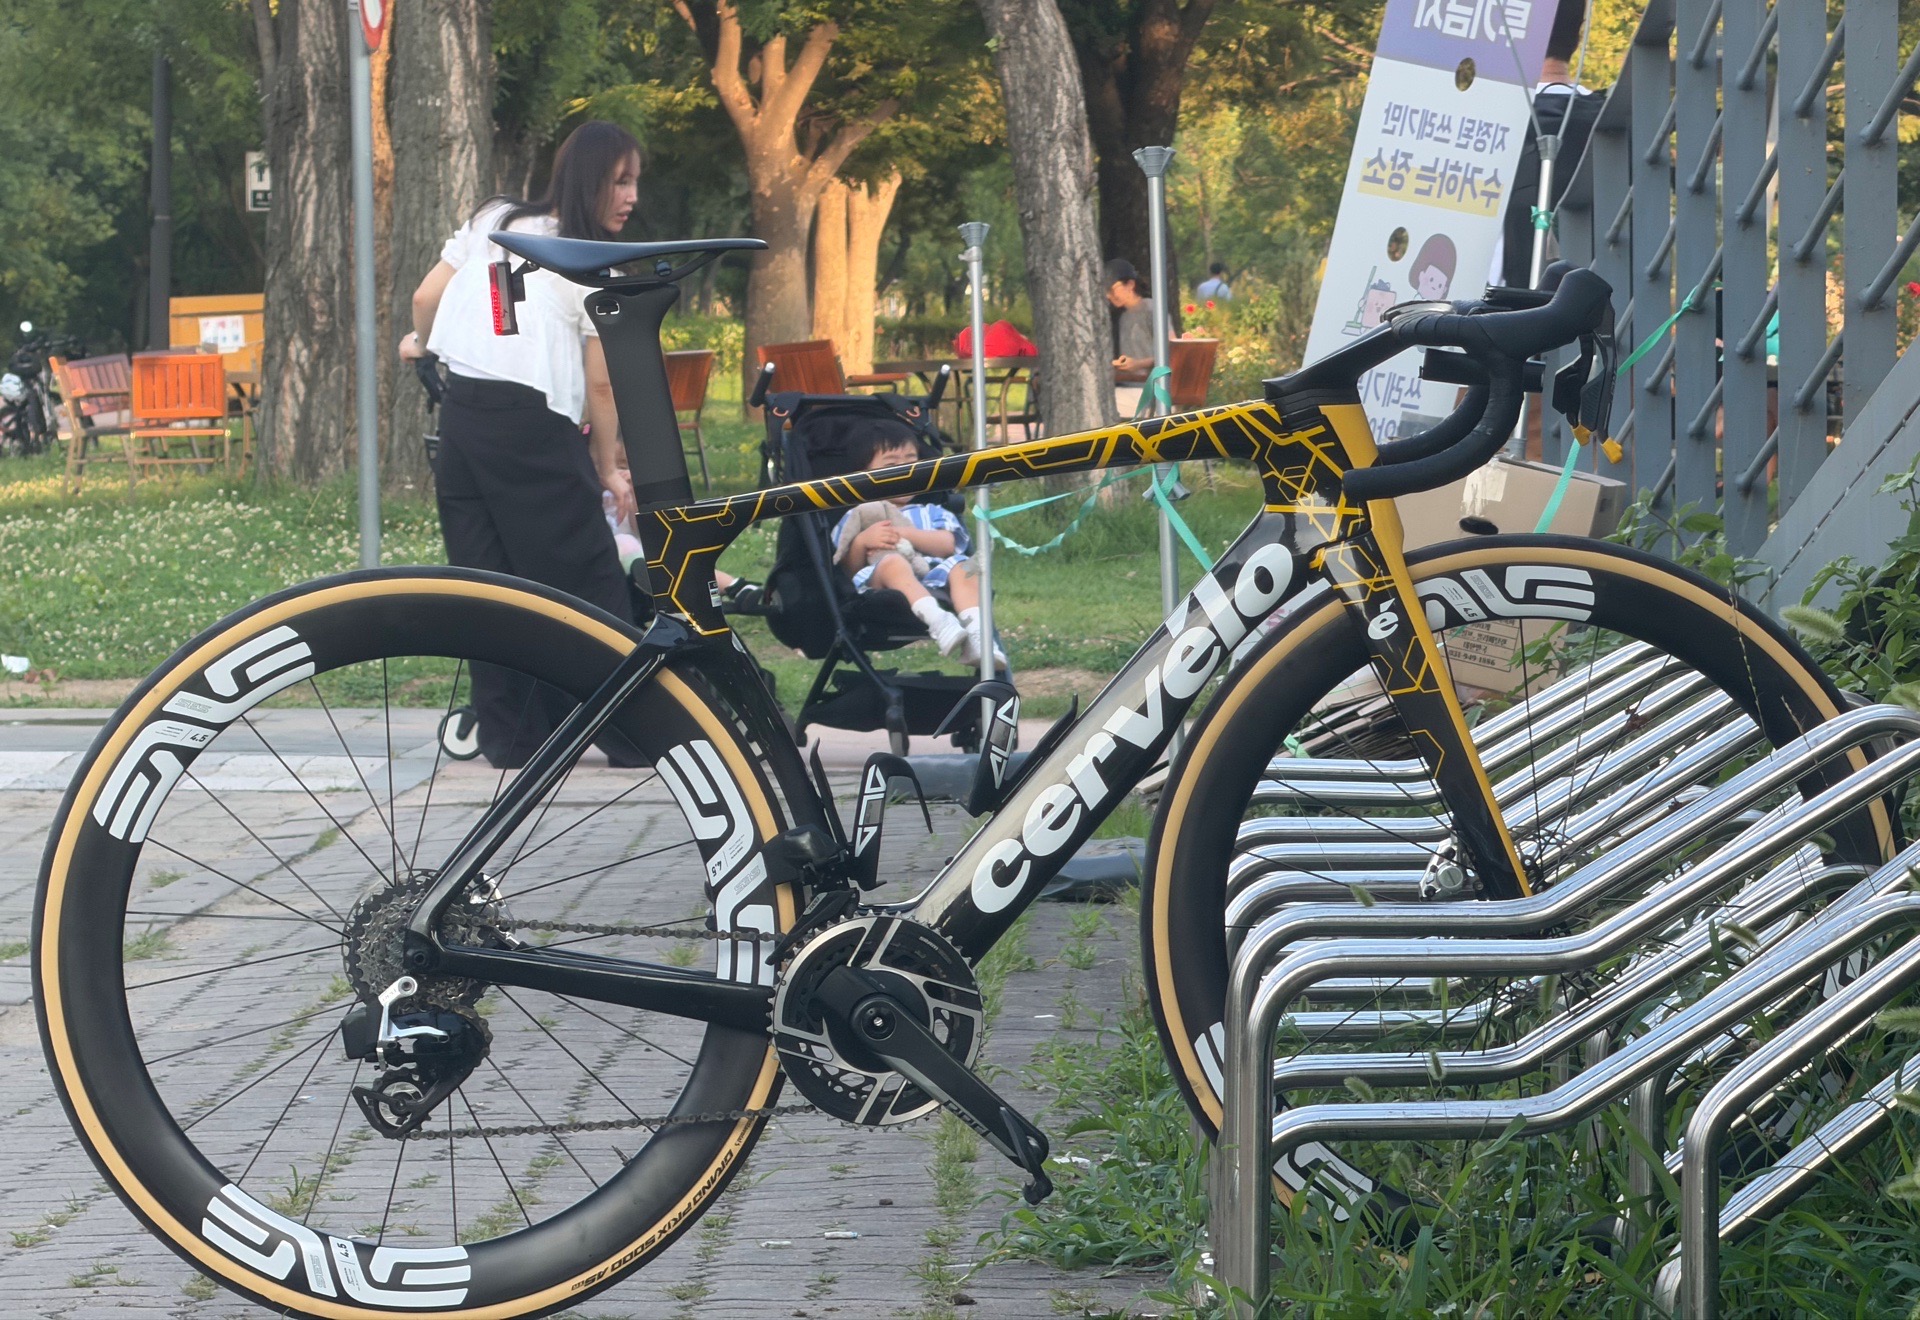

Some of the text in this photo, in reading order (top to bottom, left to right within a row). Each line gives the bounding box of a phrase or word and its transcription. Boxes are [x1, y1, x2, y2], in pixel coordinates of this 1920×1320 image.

[1462, 606, 1478, 618] 4.5
[190, 733, 209, 743] 4.5
[711, 859, 722, 877] 4.5
[692, 1149, 734, 1206] GRAND
[658, 1202, 693, 1239] PRIX
[336, 1242, 350, 1258] 4.5
[610, 1236, 656, 1273] 5000
